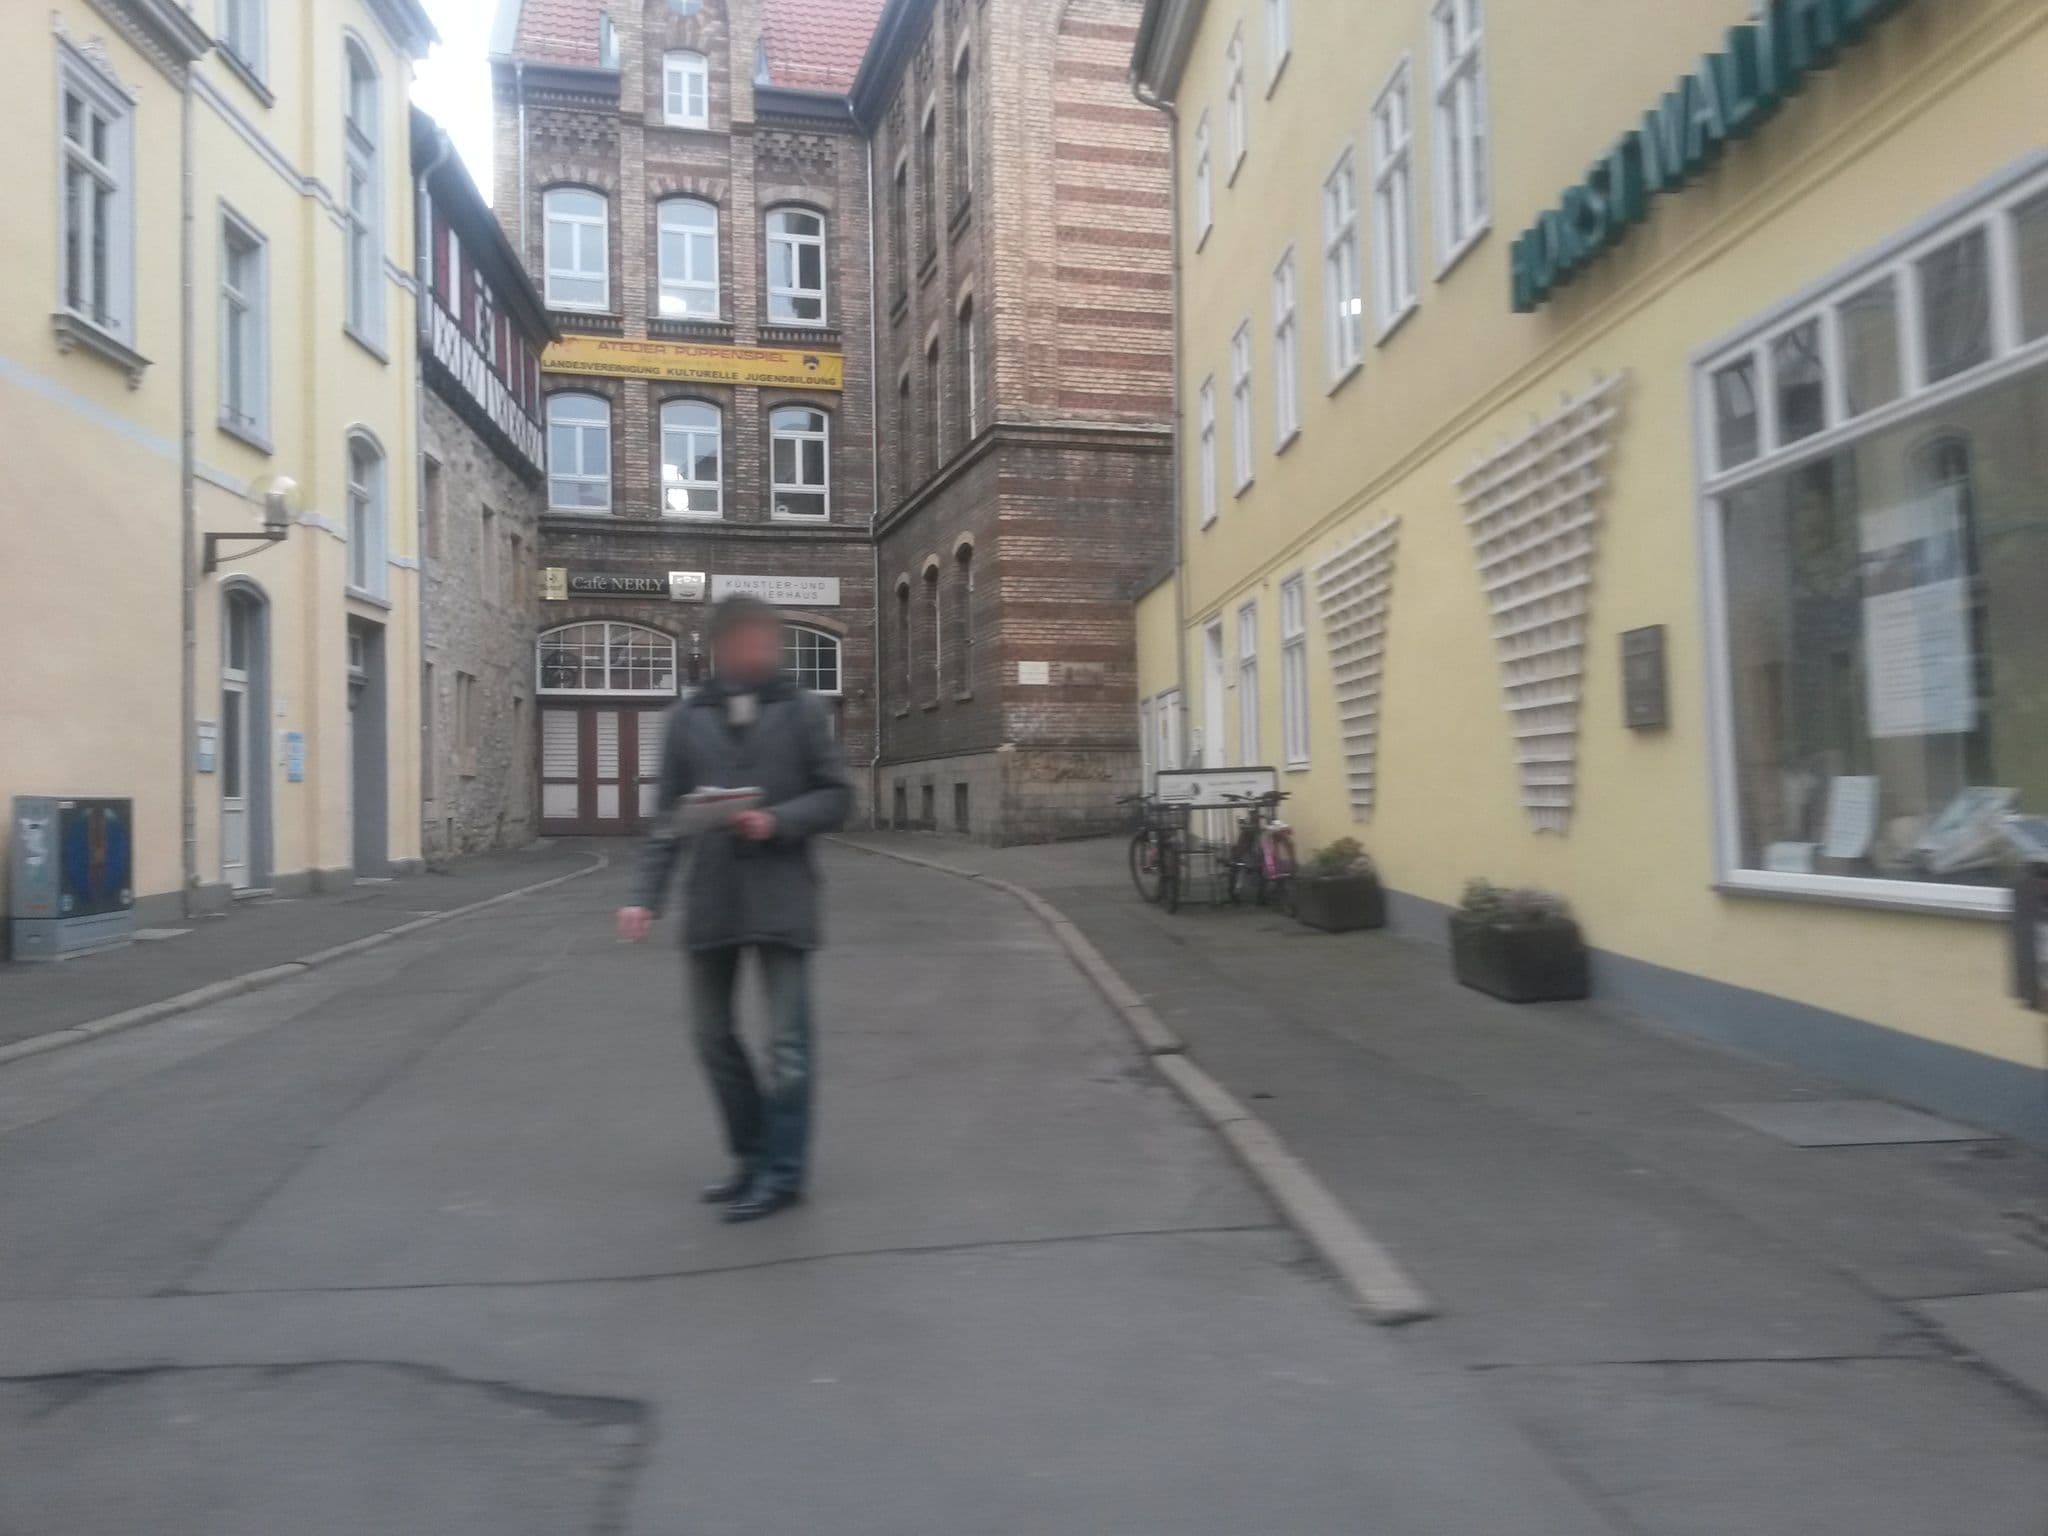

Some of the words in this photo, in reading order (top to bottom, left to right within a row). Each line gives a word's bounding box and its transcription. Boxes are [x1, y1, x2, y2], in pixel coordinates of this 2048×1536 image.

[597, 341, 667, 355] ATELIER
[674, 345, 788, 363] PUPPENSPIEL
[542, 359, 661, 375] LANDESVEREINIGUNG
[667, 367, 740, 380] KULTURELLE
[744, 372, 837, 386] JUGENDBILDUNG
[571, 576, 607, 590] Café
[611, 577, 665, 591] NERLY
